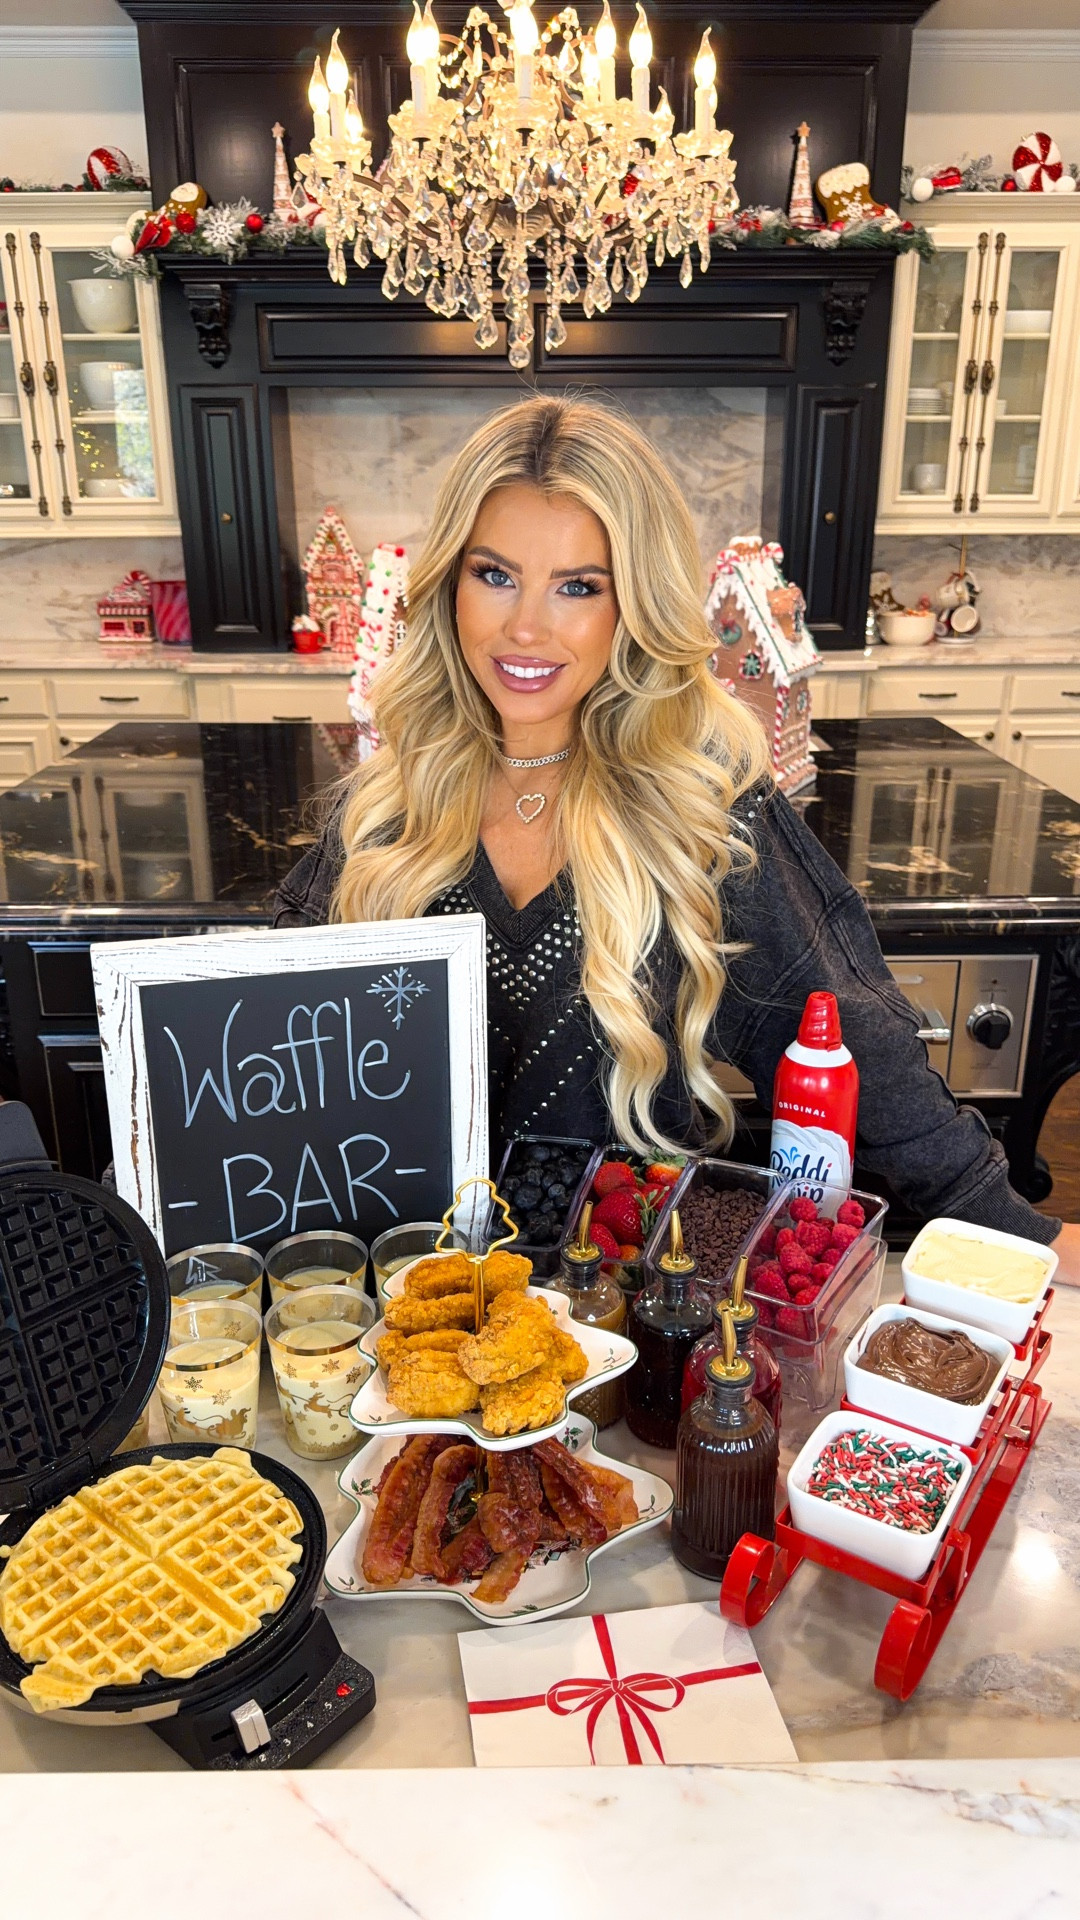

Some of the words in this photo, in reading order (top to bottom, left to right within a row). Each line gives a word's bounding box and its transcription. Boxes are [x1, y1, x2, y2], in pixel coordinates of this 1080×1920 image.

[163, 997, 411, 1128] Waffle
[778, 1101, 826, 1118] ORIGINAL
[770, 1150, 832, 1188] Reddi
[283, 1738, 291, 1747] 3
